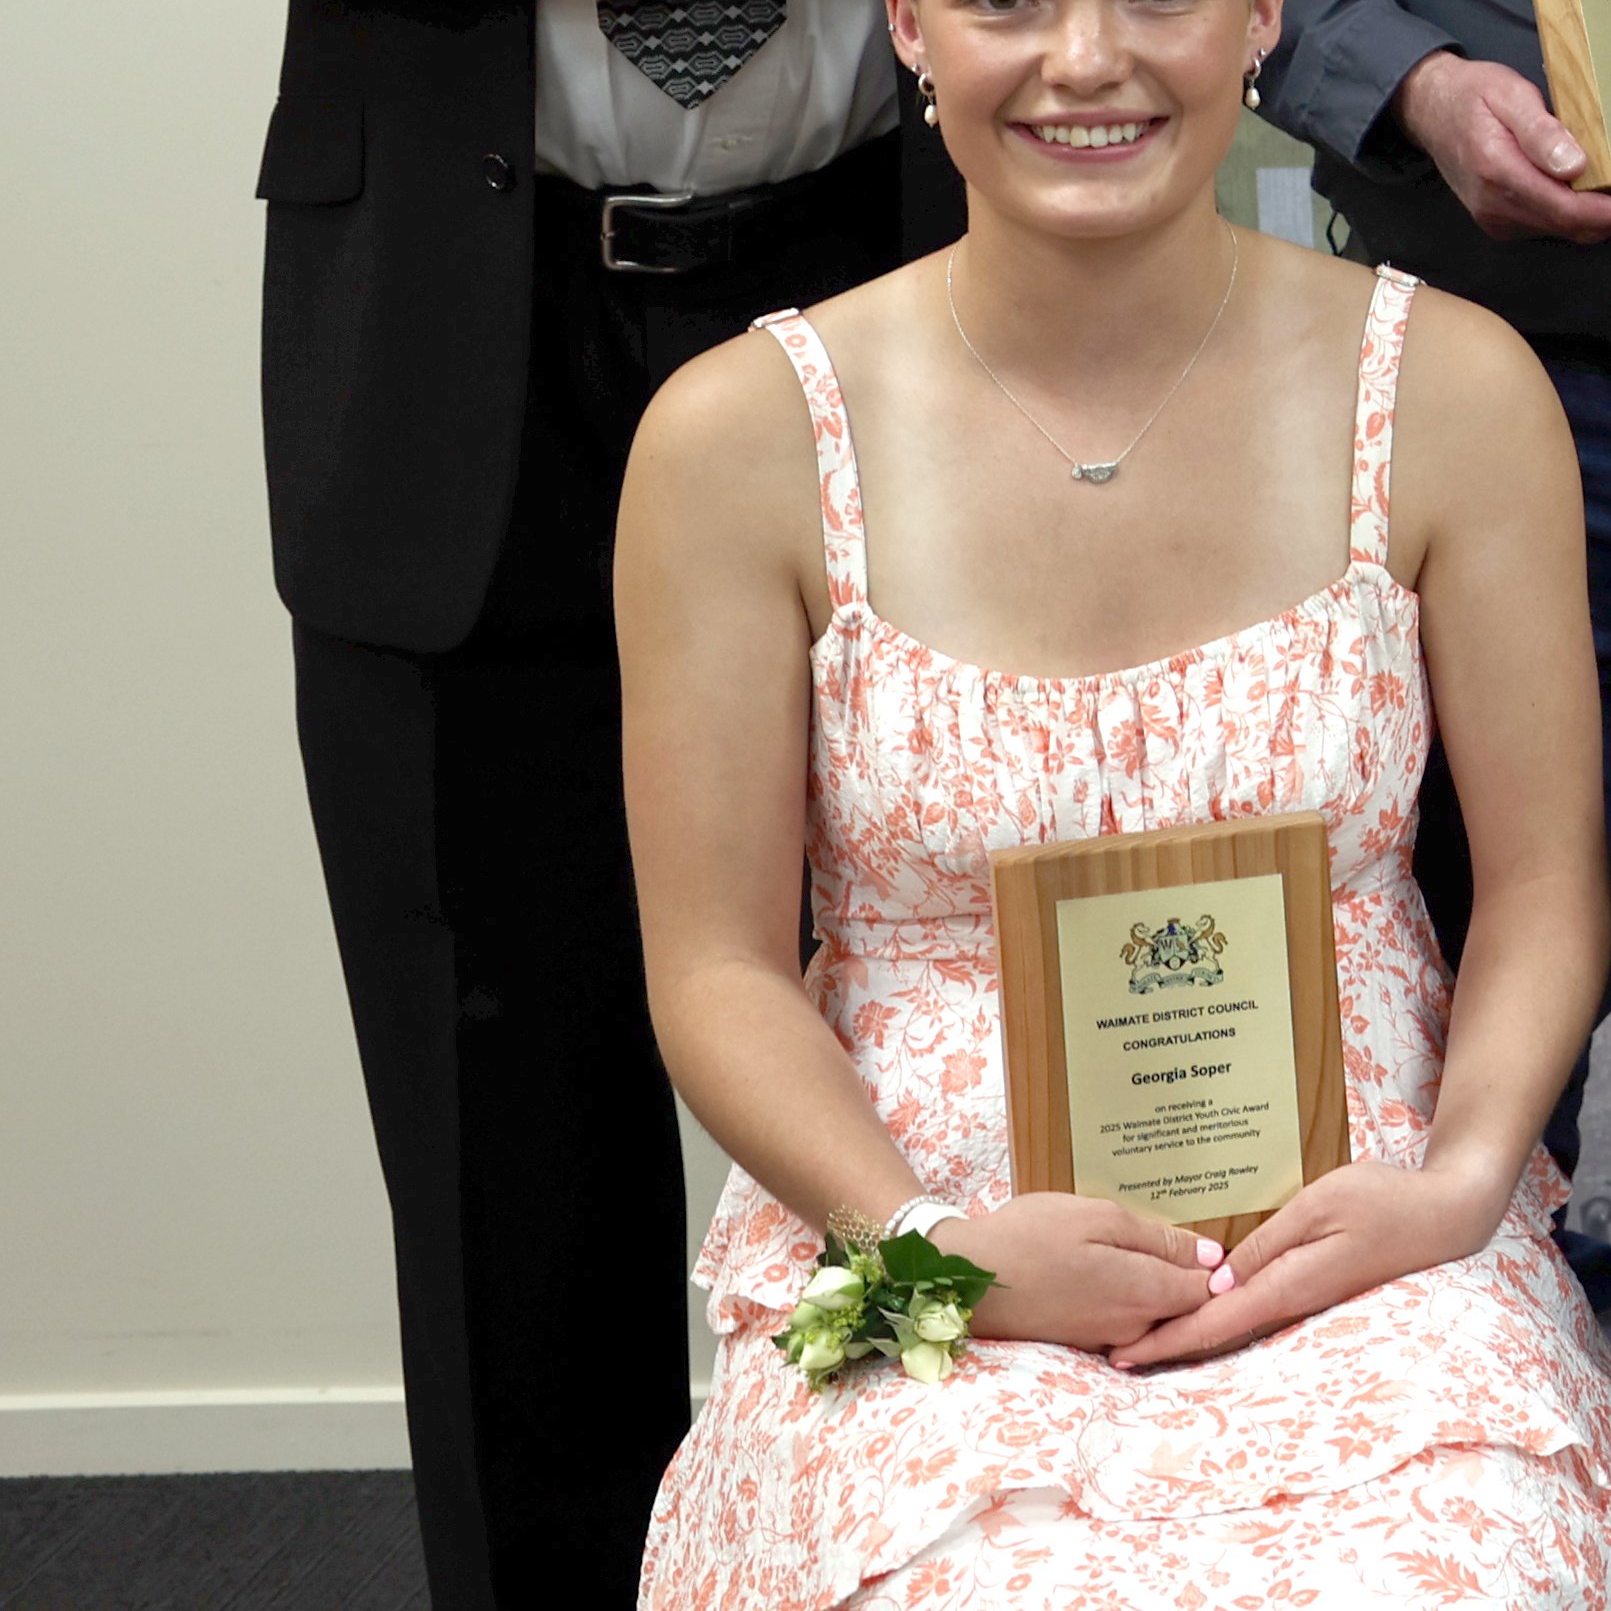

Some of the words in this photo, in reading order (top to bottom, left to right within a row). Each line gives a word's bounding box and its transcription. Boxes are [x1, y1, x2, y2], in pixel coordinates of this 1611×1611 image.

[1096, 1014, 1149, 1030] WAIMATE
[1152, 1006, 1205, 1022] DISTRICT
[1207, 1000, 1259, 1015] COUNCIL
[1123, 1027, 1236, 1052] CONGRATULATIONS
[1131, 1067, 1187, 1085] Georgia
[1190, 1063, 1232, 1078] Soper
[1100, 1123, 1121, 1134] 2025
[1122, 1119, 1161, 1130] Waimate
[1163, 1113, 1193, 1124] District
[1194, 1109, 1219, 1120] Youth
[1221, 1107, 1240, 1117] Civic
[1242, 1102, 1269, 1113] Award
[1154, 1105, 1167, 1113] on
[1168, 1099, 1207, 1112] receiving
[1112, 1145, 1152, 1157] voluntary
[1154, 1140, 1184, 1151] service
[1196, 1136, 1211, 1145] the
[1213, 1129, 1261, 1143] community
[1122, 1134, 1135, 1143] for
[1137, 1127, 1180, 1142] significant
[1182, 1124, 1198, 1135] and
[1199, 1119, 1249, 1132] meritorious
[1118, 1178, 1161, 1191] Presented
[1162, 1177, 1173, 1187] by
[1174, 1173, 1203, 1184] Mayor
[1204, 1170, 1227, 1180] Craig
[1228, 1165, 1258, 1176] Rowley
[1168, 1186, 1207, 1197] February
[1208, 1180, 1229, 1192] 2025
